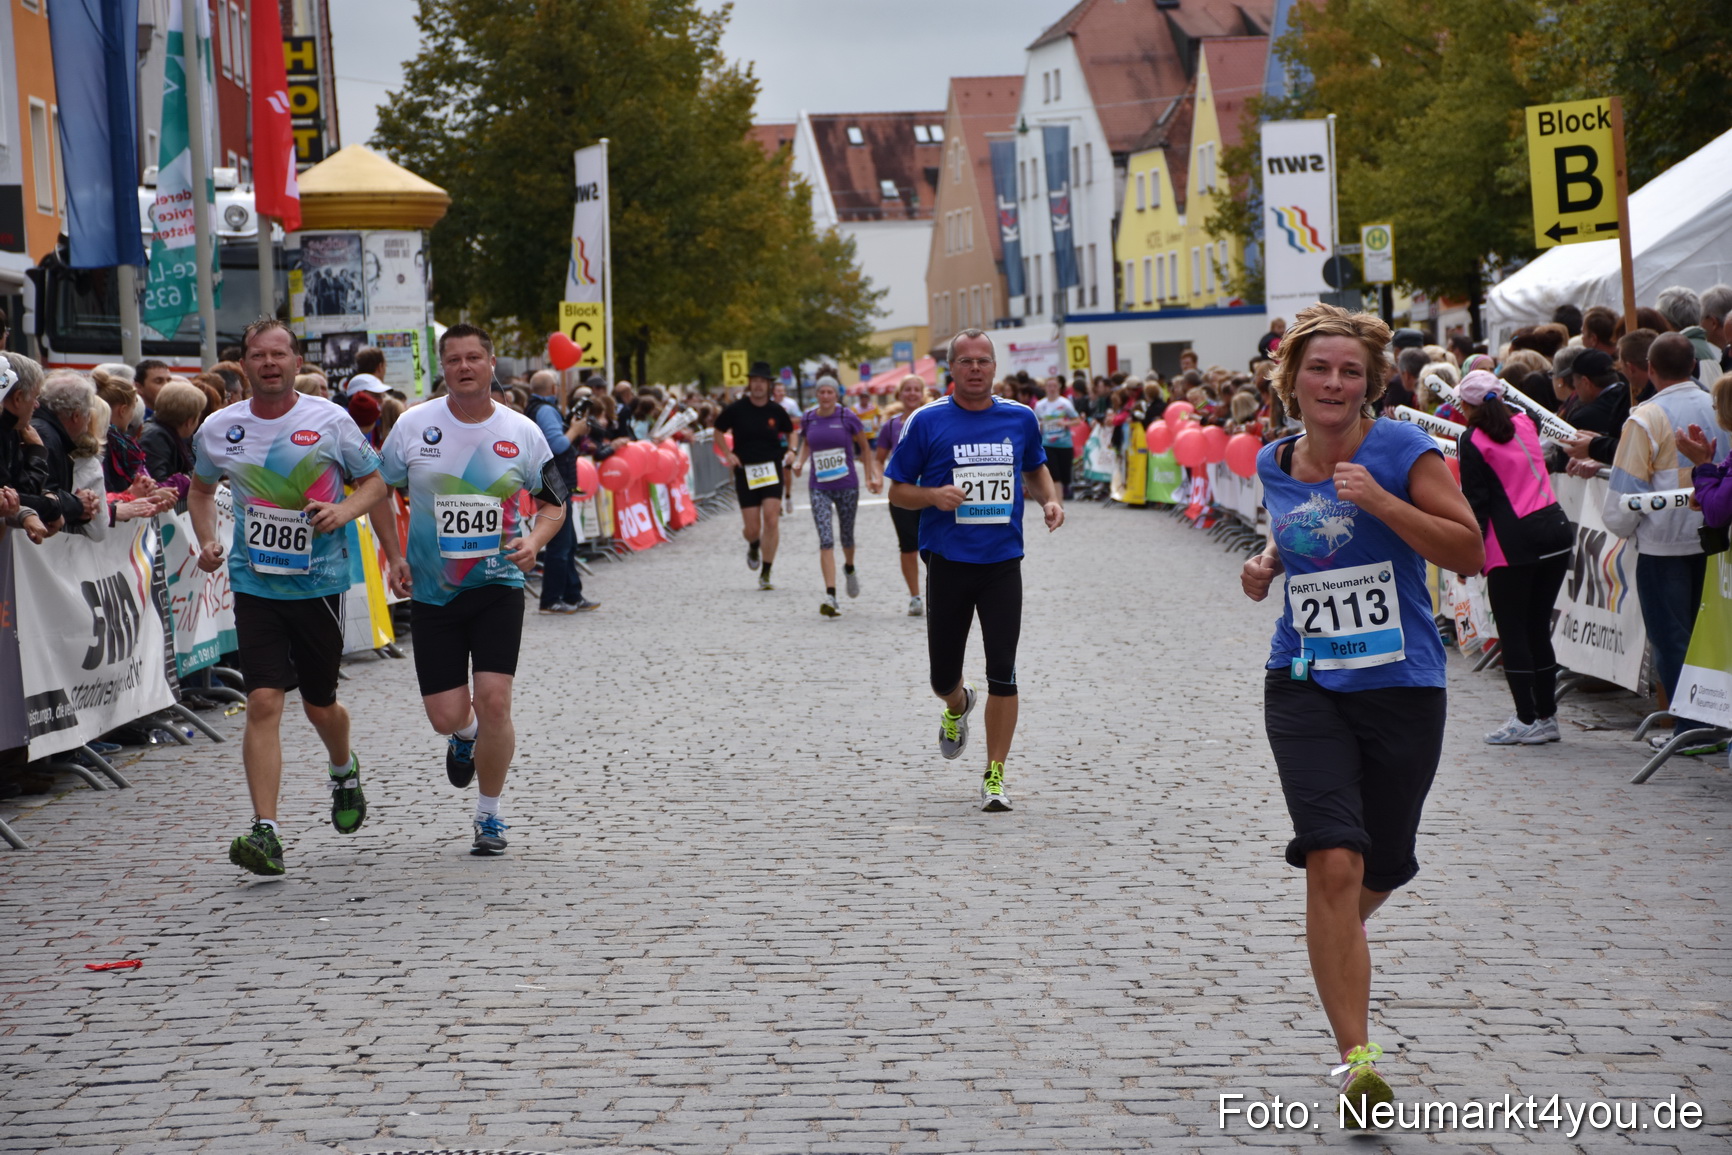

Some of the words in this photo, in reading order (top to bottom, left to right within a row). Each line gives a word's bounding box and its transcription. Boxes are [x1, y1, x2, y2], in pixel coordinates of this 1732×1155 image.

[1538, 105, 1612, 136] Block
[1554, 144, 1604, 214] B
[565, 305, 598, 316] Block
[571, 322, 592, 352] C
[1073, 345, 1085, 362] D
[729, 362, 741, 379] D
[953, 443, 1014, 458] HUBER
[817, 456, 843, 470] 3009
[752, 466, 770, 478] 231
[962, 480, 1011, 501] 2175
[247, 510, 267, 519] PARTL
[268, 514, 303, 524] Neumarkt
[969, 506, 1006, 516] Christian
[442, 509, 498, 534] 2649
[249, 521, 308, 551] 2086
[461, 540, 478, 550] Jan
[258, 552, 290, 566] Darius
[485, 556, 500, 568] 16.
[1291, 583, 1321, 595] PARTL
[1322, 575, 1375, 591] Neumarkt
[1301, 588, 1390, 633] 2113
[1331, 641, 1367, 656] Petra
